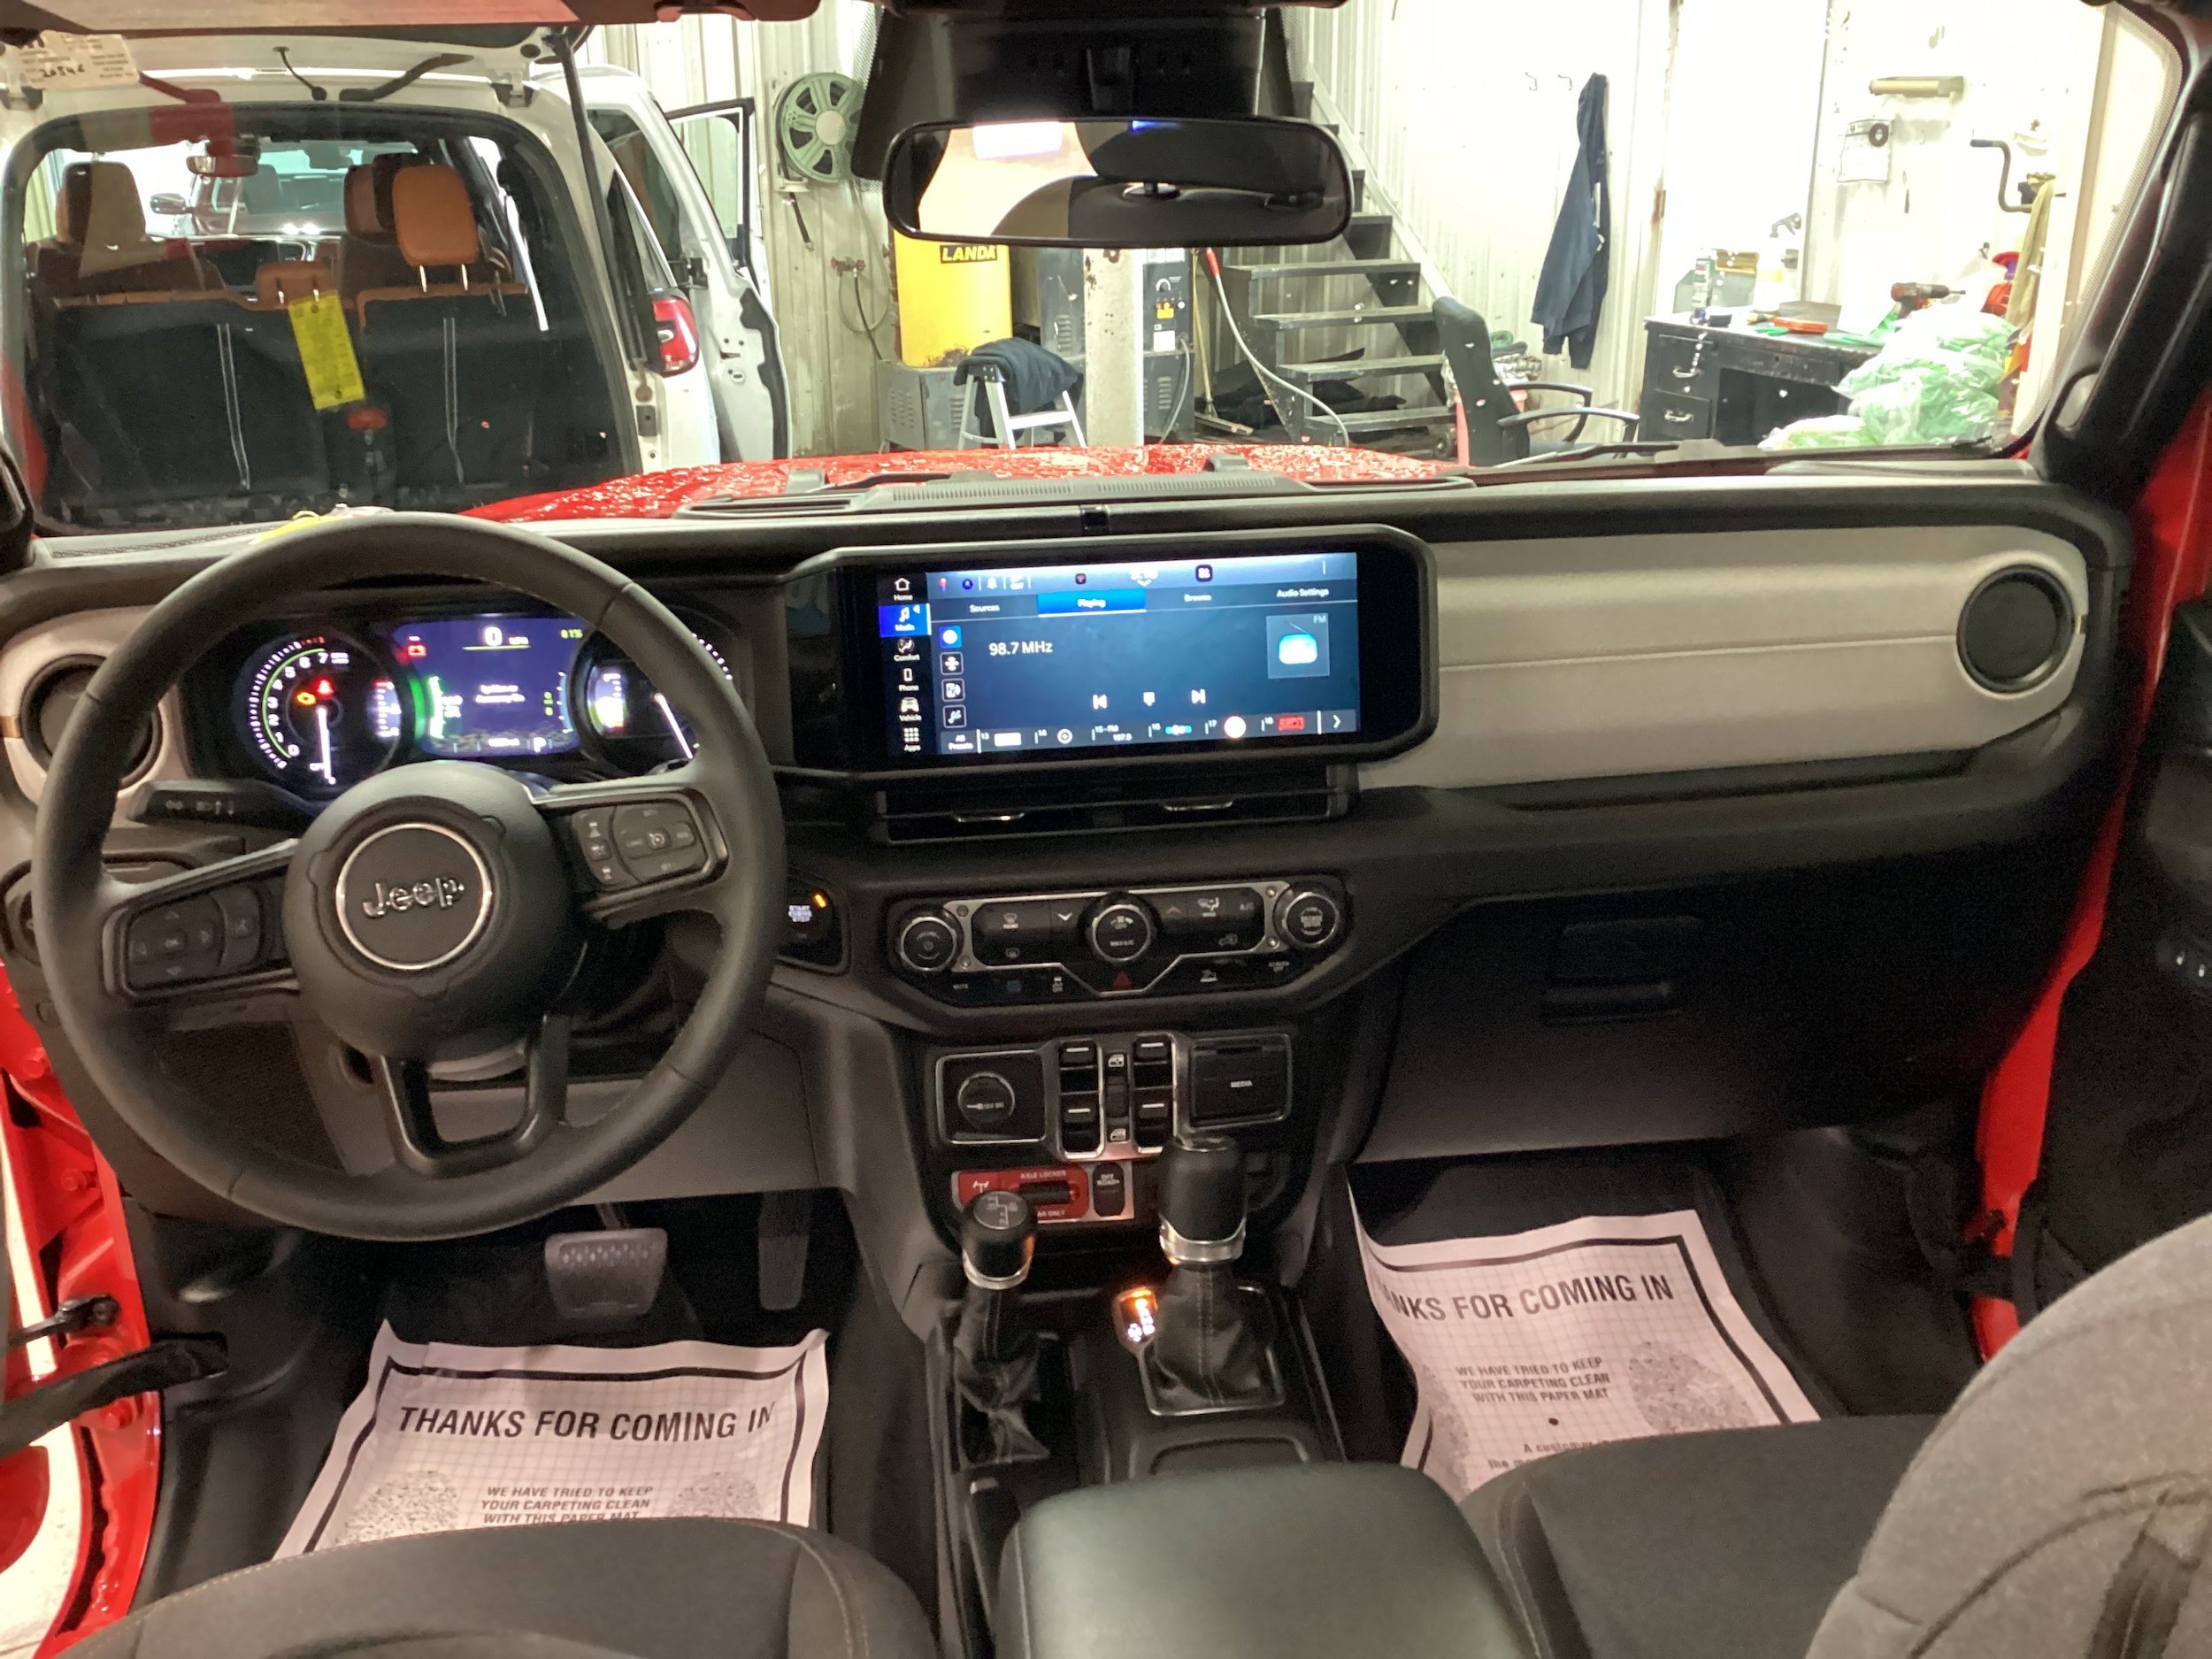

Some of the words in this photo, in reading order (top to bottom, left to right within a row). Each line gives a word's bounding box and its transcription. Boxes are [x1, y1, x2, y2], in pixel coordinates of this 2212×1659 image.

[942, 245, 997, 261] LANDA
[1277, 588, 1299, 598] Audio
[1300, 587, 1330, 597] Settings
[970, 604, 1000, 613] Sources
[1077, 598, 1107, 609] Playing
[1313, 615, 1327, 624] FM
[988, 641, 1019, 657] 98.7
[1021, 640, 1054, 654] MHz
[299, 657, 311, 669] 6
[318, 652, 328, 664] 7
[894, 653, 921, 663] Comfort
[284, 666, 296, 679] 5
[272, 679, 284, 690] 4
[898, 684, 920, 693] Phone
[267, 696, 279, 709] 3
[268, 714, 280, 726] 2
[275, 731, 285, 743] 1
[534, 736, 547, 752] P
[288, 744, 300, 757] 0
[363, 878, 465, 918] Jeep
[1231, 1079, 1253, 1088] MEDIA
[1040, 1170, 1067, 1179] LOCKER
[1452, 1294, 1514, 1320] FOR
[1519, 1274, 1638, 1316] COMING
[1640, 1274, 1674, 1301] IN
[1455, 1365, 1473, 1377] WE
[1478, 1364, 1509, 1376] HAVE
[1513, 1363, 1549, 1376] TRIED
[1553, 1363, 1569, 1374] TO
[1572, 1356, 1602, 1371] KEEP
[1460, 1379, 1495, 1390] YOUR
[1498, 1377, 1567, 1389] CARPETING
[1570, 1372, 1611, 1387] CLEAN
[1472, 1391, 1506, 1403] WITH
[1509, 1391, 1538, 1402] THIS
[1540, 1389, 1580, 1402] PAPER
[1583, 1387, 1609, 1401] MAT
[399, 1406, 526, 1438] THANKS
[534, 1409, 600, 1439] FOR
[611, 1411, 737, 1442] COMING
[747, 1401, 776, 1433] IN
[488, 1486, 507, 1497] WE
[511, 1486, 548, 1497] HAVE
[553, 1487, 592, 1498] TRIED
[598, 1487, 614, 1497] TO
[619, 1486, 653, 1496] KEEP
[482, 1500, 519, 1510] YOUR
[524, 1500, 601, 1510] CARPETING
[606, 1499, 650, 1509] CLEAN
[483, 1513, 520, 1524] WITH
[526, 1513, 559, 1524] THIS
